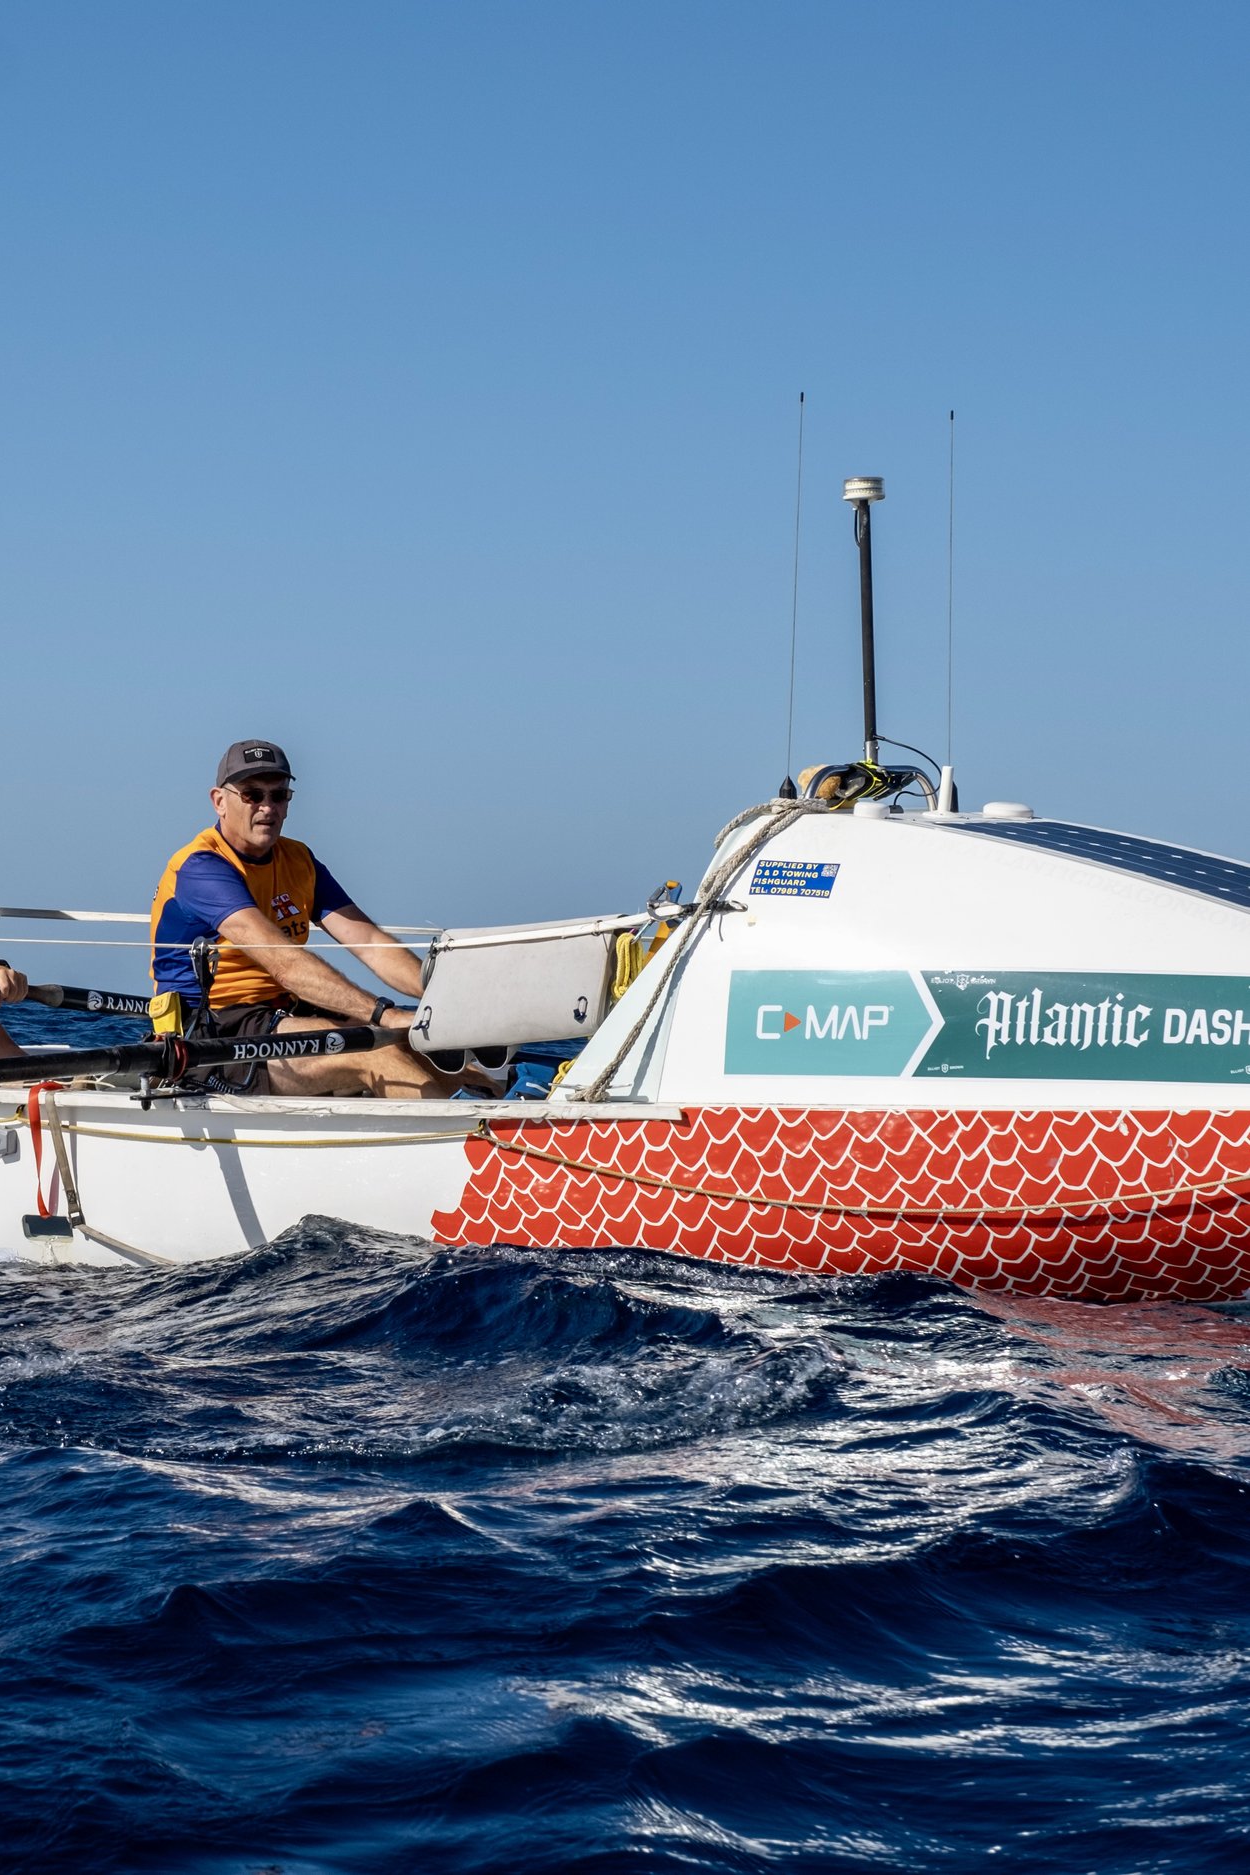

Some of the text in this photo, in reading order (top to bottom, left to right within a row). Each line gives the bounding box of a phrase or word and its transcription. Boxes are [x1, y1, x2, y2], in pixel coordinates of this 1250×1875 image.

[759, 861, 804, 869] SUPPLIED
[782, 870, 819, 878] TOWING
[753, 878, 806, 886] FISHGUARD
[106, 996, 150, 1014] RANNO
[975, 987, 1250, 1060] Atlantic DASH
[233, 1039, 320, 1060] RANNOCH
